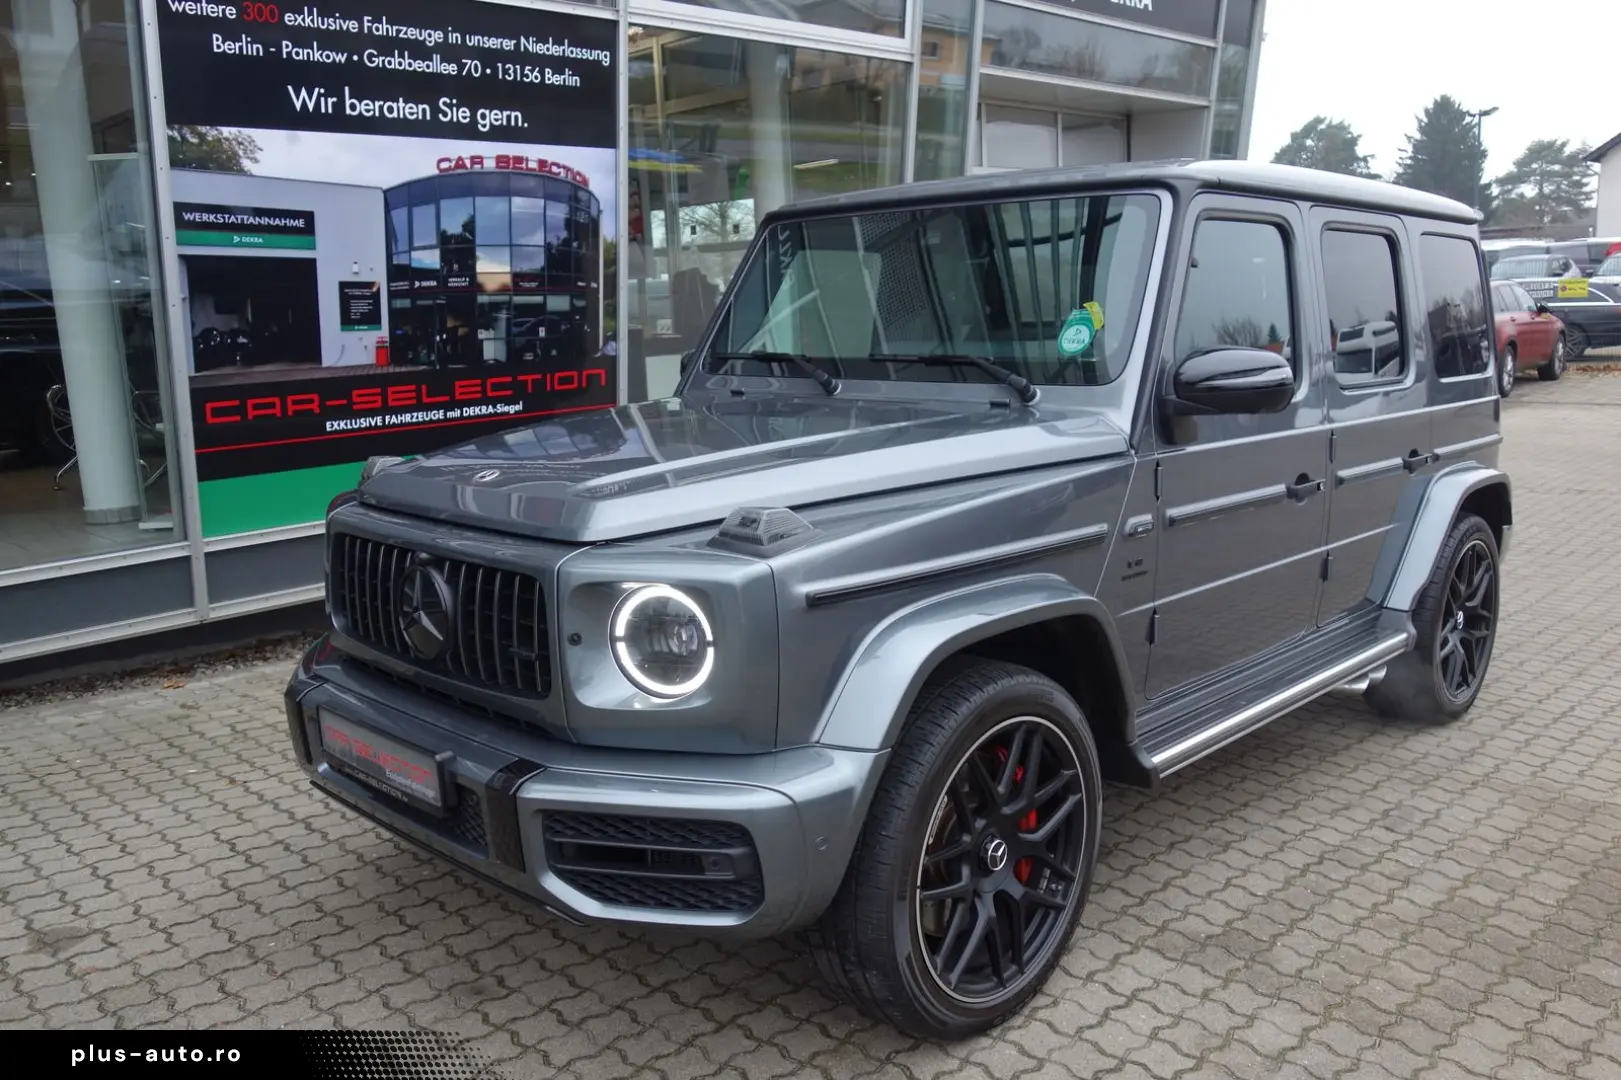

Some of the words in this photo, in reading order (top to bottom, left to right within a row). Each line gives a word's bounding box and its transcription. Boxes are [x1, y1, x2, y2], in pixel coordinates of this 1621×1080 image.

[168, 0, 236, 19] weitere
[242, 1, 279, 23] 300
[284, 7, 358, 32] exklusive
[364, 16, 444, 47] Fahrzeuge
[448, 27, 461, 44] in
[466, 35, 516, 51] unserer
[520, 35, 610, 66] Niederlassung
[212, 33, 263, 57] Berlin
[282, 40, 347, 64] Pankow
[363, 49, 458, 75] Grabbeallee
[462, 59, 481, 77] 70
[497, 63, 541, 83] 13156
[545, 68, 580, 87] Berlin
[287, 85, 337, 114] Wir
[345, 86, 431, 120] beraten
[438, 97, 470, 124] Sie
[477, 108, 528, 132] gern.
[436, 155, 484, 173] CAR
[495, 154, 590, 188] SELECTION
[182, 212, 305, 227] WERKSTATTANNAHME
[205, 368, 606, 424] CAR-SELECTION
[326, 415, 383, 432] EXKLUSIVE
[385, 409, 445, 425] FAHRZEUGE
[447, 406, 461, 419] mit
[463, 401, 523, 417] DEKRA-Siegel
